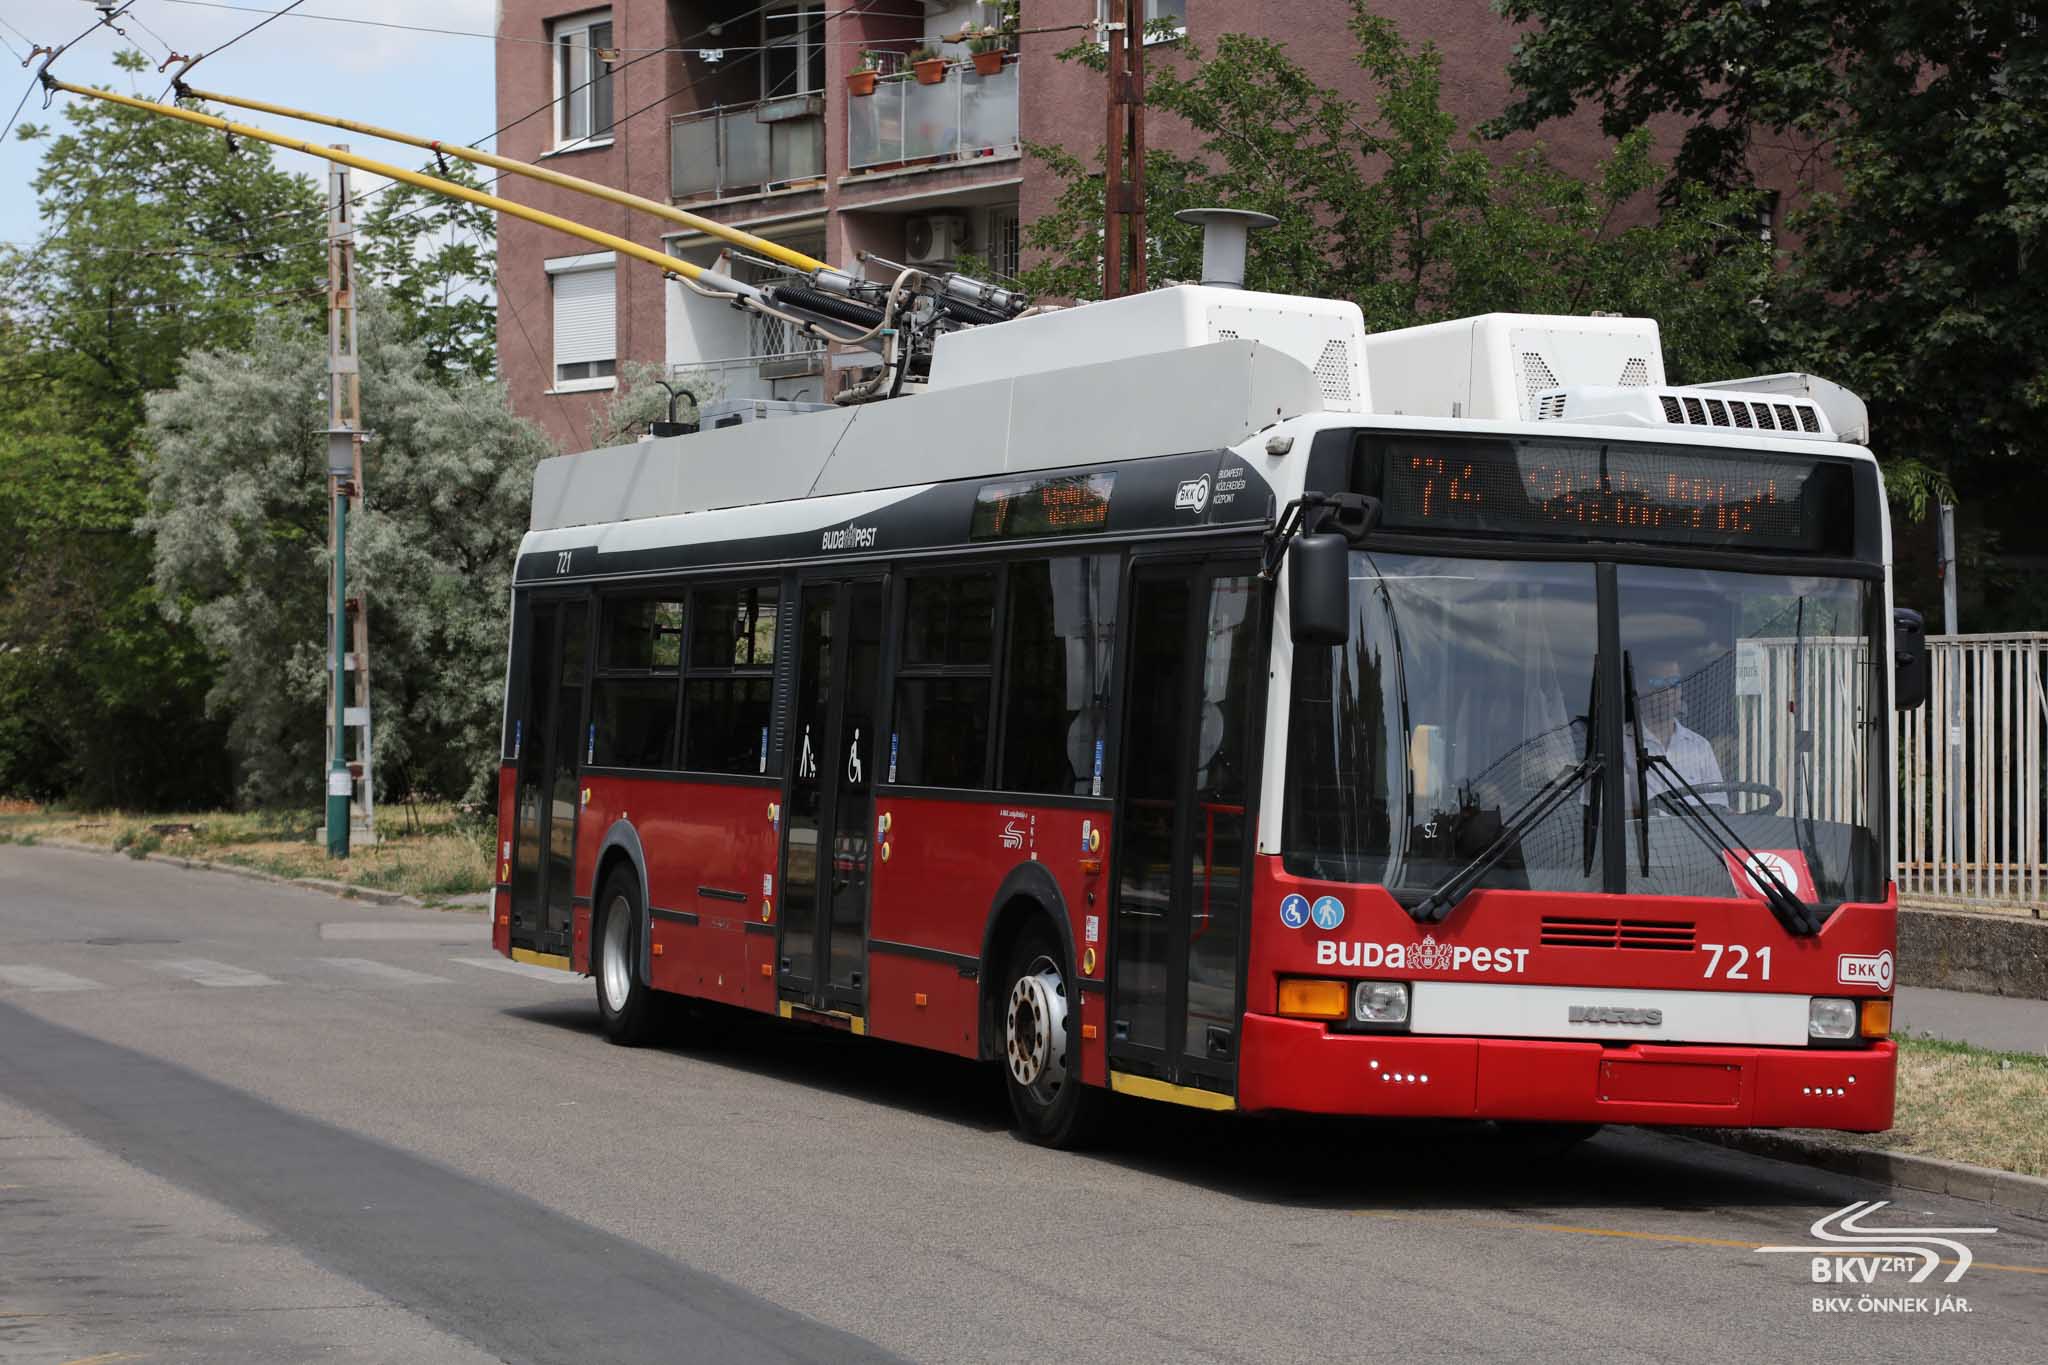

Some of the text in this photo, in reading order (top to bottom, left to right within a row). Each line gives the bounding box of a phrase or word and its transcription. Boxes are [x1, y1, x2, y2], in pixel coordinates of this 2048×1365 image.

[556, 551, 572, 574] 721
[1701, 943, 1772, 981] 721
[1847, 962, 1877, 977] BKK
